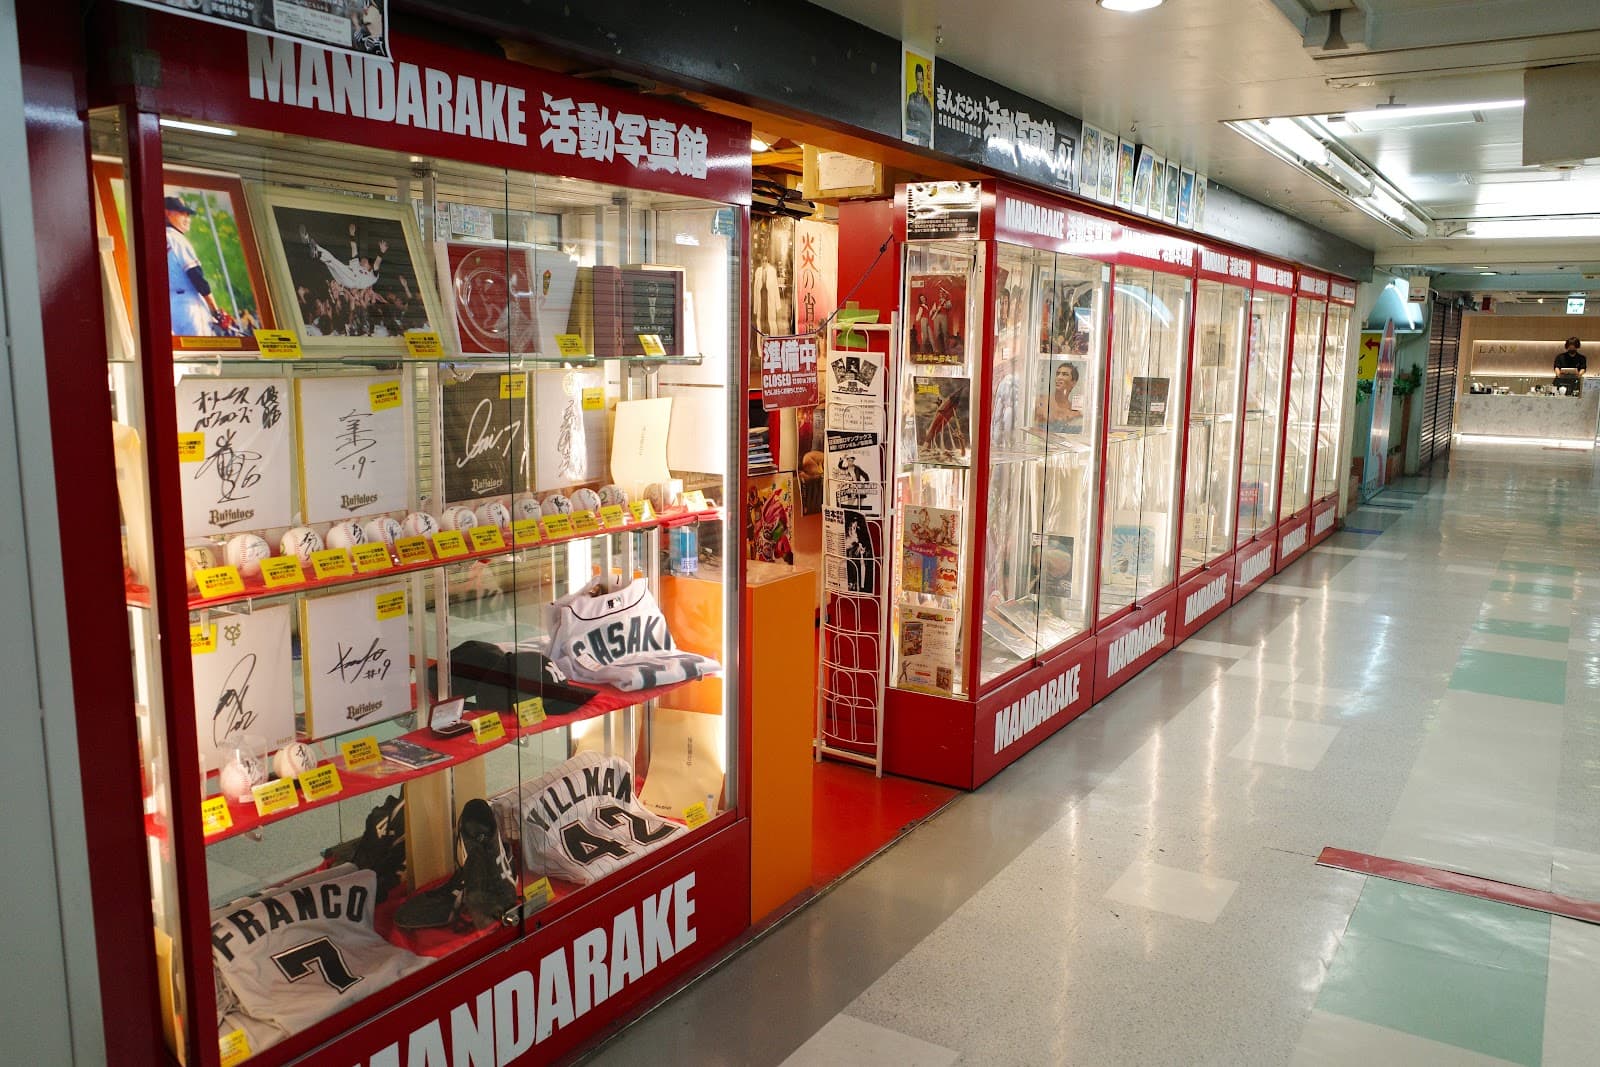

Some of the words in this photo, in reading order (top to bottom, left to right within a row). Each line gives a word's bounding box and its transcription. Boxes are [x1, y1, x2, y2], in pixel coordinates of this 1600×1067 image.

[247, 31, 527, 146] MANDARAKE
[539, 91, 709, 180] 活動写真館
[1005, 196, 1065, 239] MANDARAKE
[763, 339, 816, 374] 準備中
[763, 374, 792, 388] CLOSED
[208, 508, 255, 527] Buffaloes
[340, 493, 378, 512] Buffaloes
[1107, 609, 1167, 679] MANDARAKE
[346, 699, 384, 722] Buffaloes
[993, 663, 1081, 755] MANDARAKE
[559, 803, 681, 866] 42
[212, 883, 369, 962] FRANCO
[270, 935, 366, 995] 7
